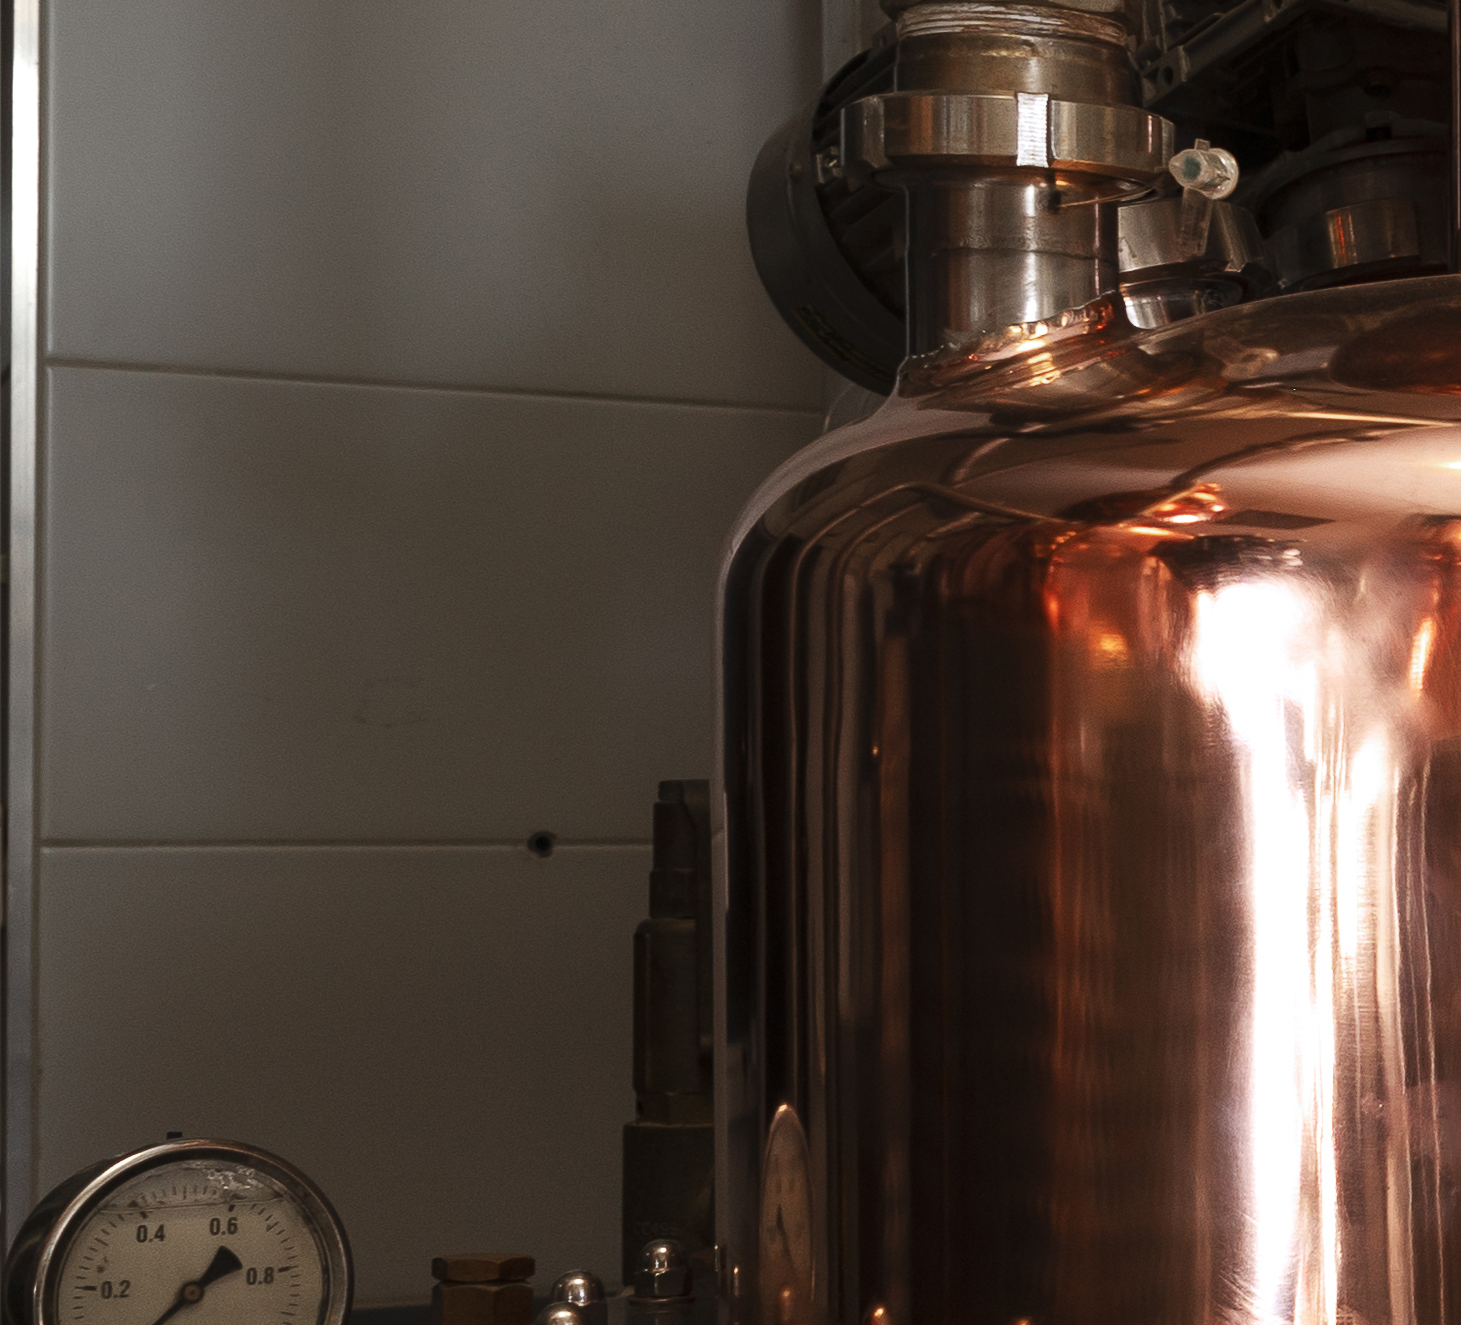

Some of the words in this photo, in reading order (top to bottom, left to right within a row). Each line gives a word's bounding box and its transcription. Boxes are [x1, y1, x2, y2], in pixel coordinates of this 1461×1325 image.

[136, 1224, 166, 1243] 0.4
[209, 1216, 239, 1236] 0.6
[245, 1267, 275, 1286] 0.8
[101, 1280, 131, 1299] 0.2
